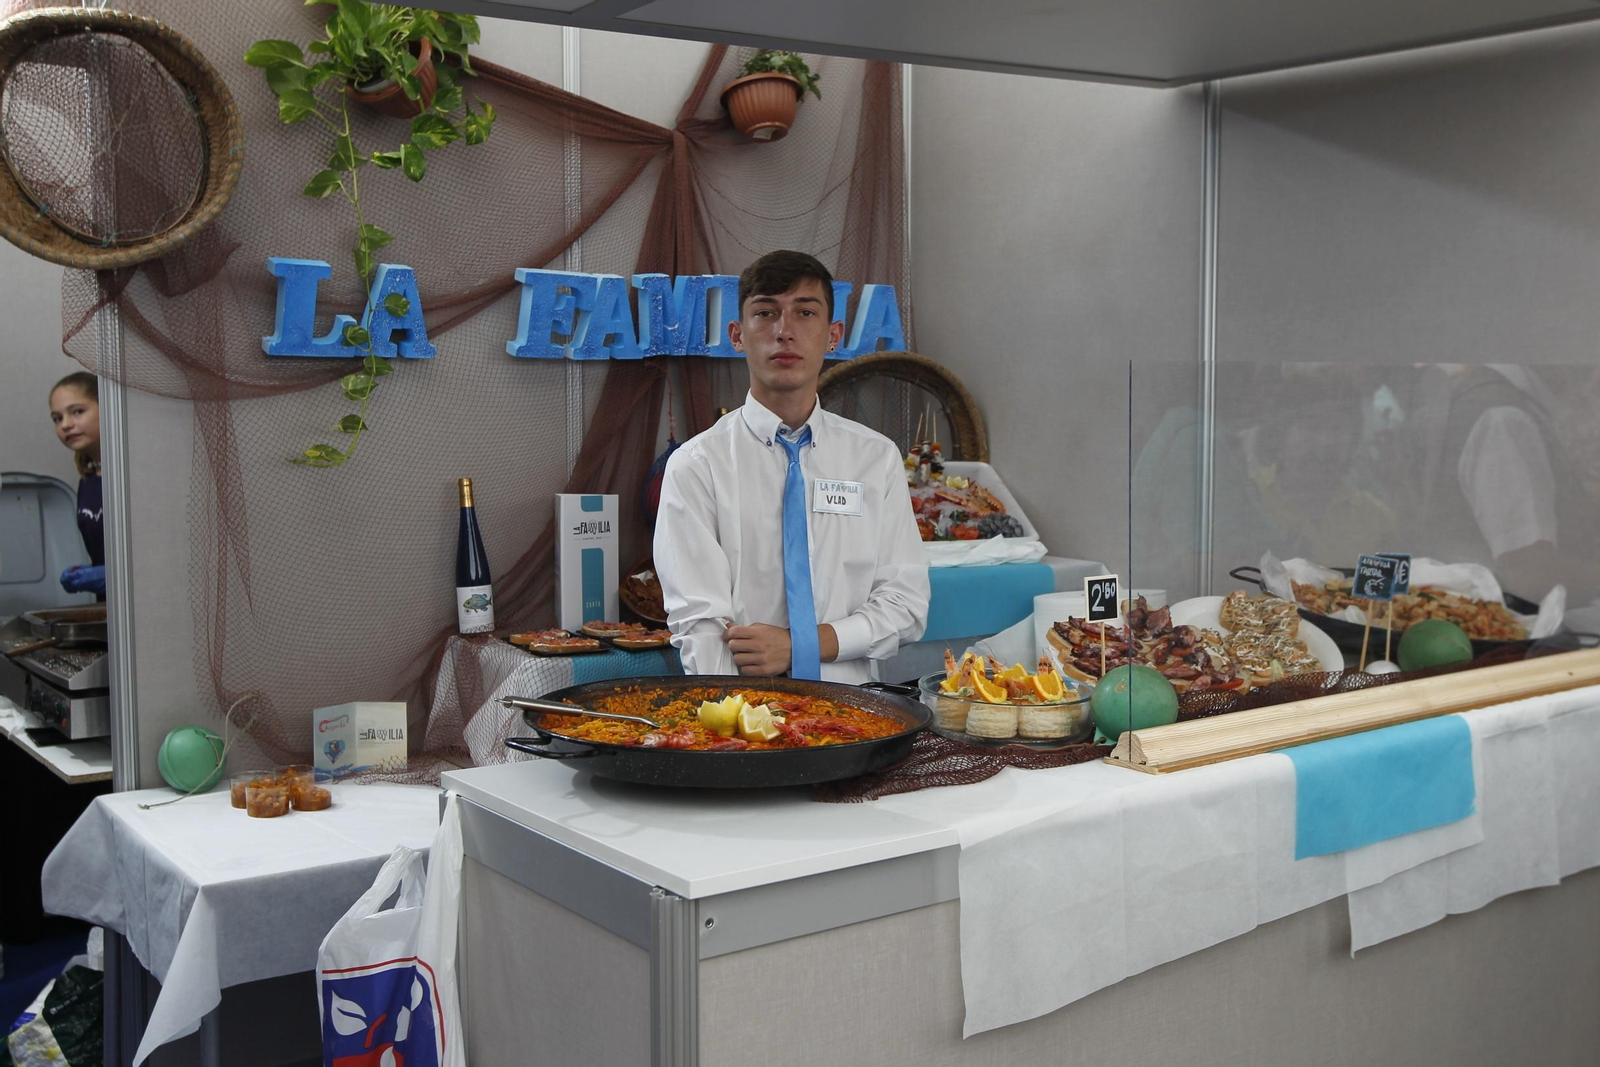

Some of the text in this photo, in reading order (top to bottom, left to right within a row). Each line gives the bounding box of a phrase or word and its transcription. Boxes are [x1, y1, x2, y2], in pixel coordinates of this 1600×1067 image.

[261, 256, 905, 360] LA FAMIIA
[826, 495, 847, 505] VLAD
